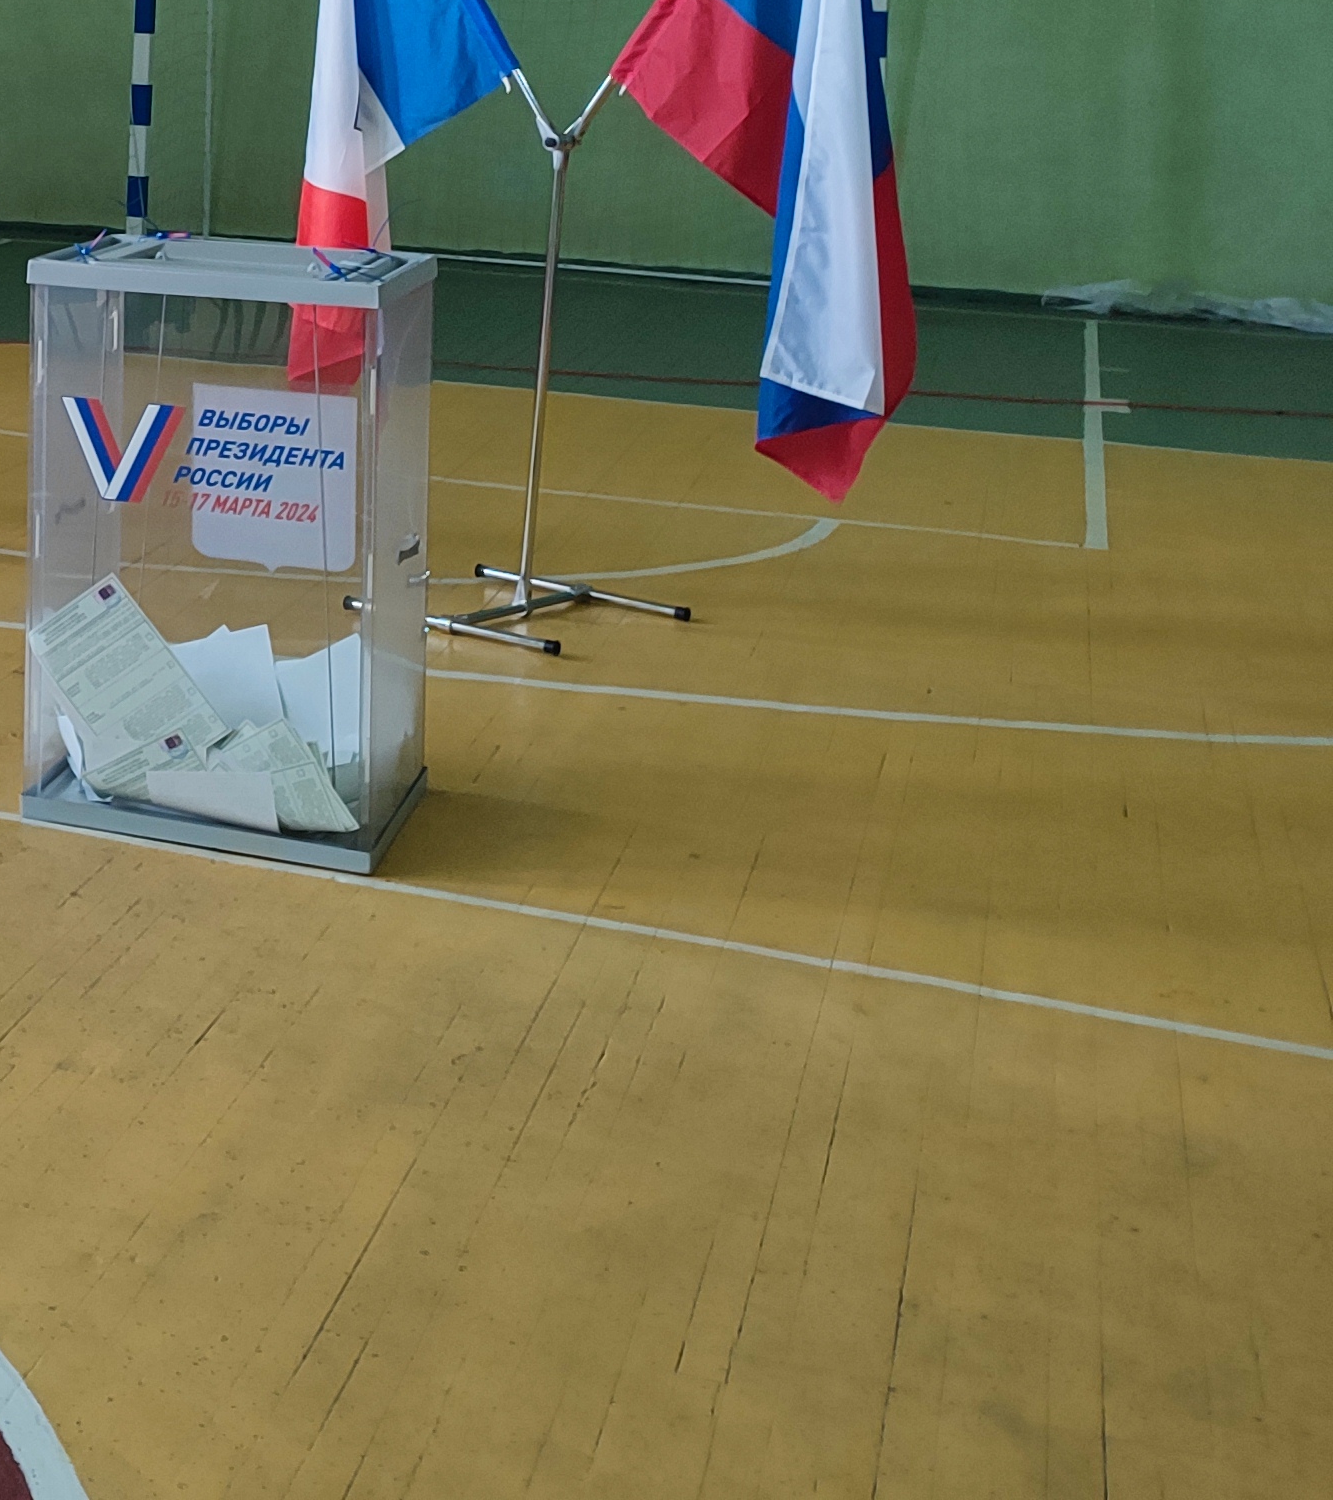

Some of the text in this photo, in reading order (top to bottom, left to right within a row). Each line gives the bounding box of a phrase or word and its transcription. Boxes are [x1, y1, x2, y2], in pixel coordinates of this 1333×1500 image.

[198, 409, 311, 436] ВЫБОРЫ
[186, 437, 345, 471] ПРЕЗИДЕНТА
[173, 465, 274, 493] РОССИИ
[211, 494, 272, 519] МАРТА
[274, 501, 320, 523] 2024
